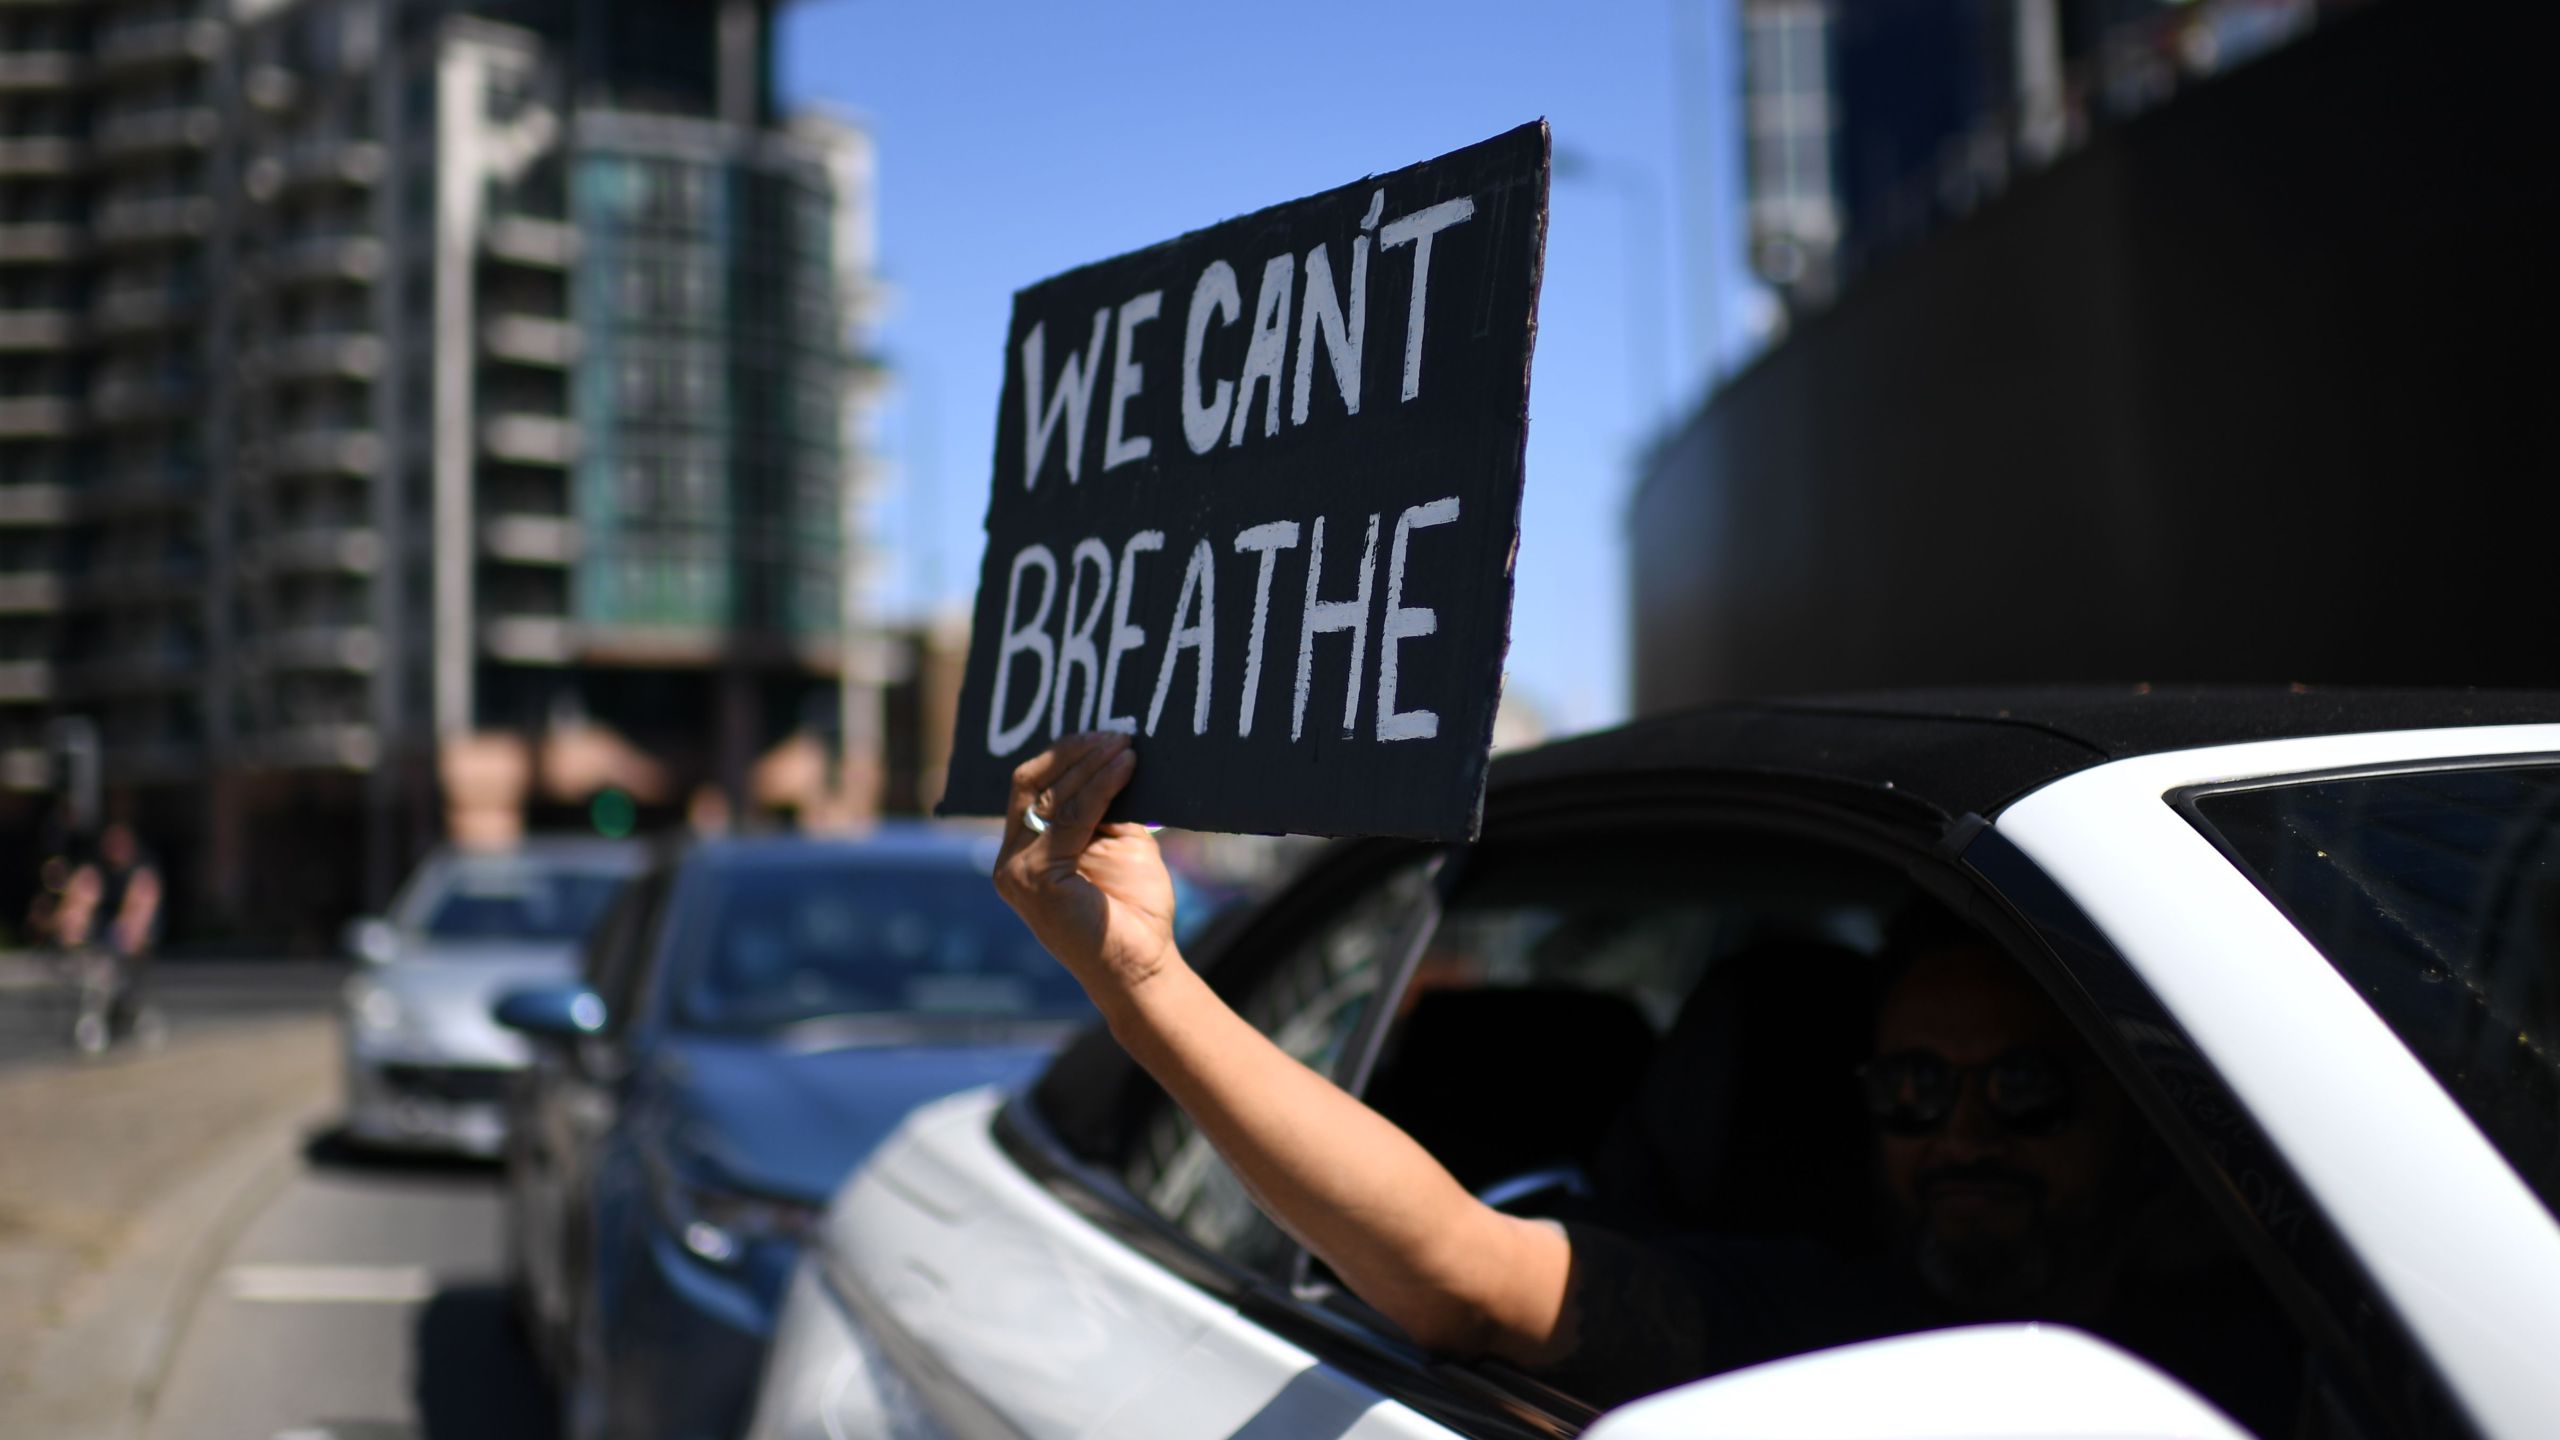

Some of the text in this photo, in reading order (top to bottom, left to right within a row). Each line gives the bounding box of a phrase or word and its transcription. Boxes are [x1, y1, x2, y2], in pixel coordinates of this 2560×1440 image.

[1022, 188, 1475, 490] WE CAN'T
[987, 496, 1460, 757] BREATHE
